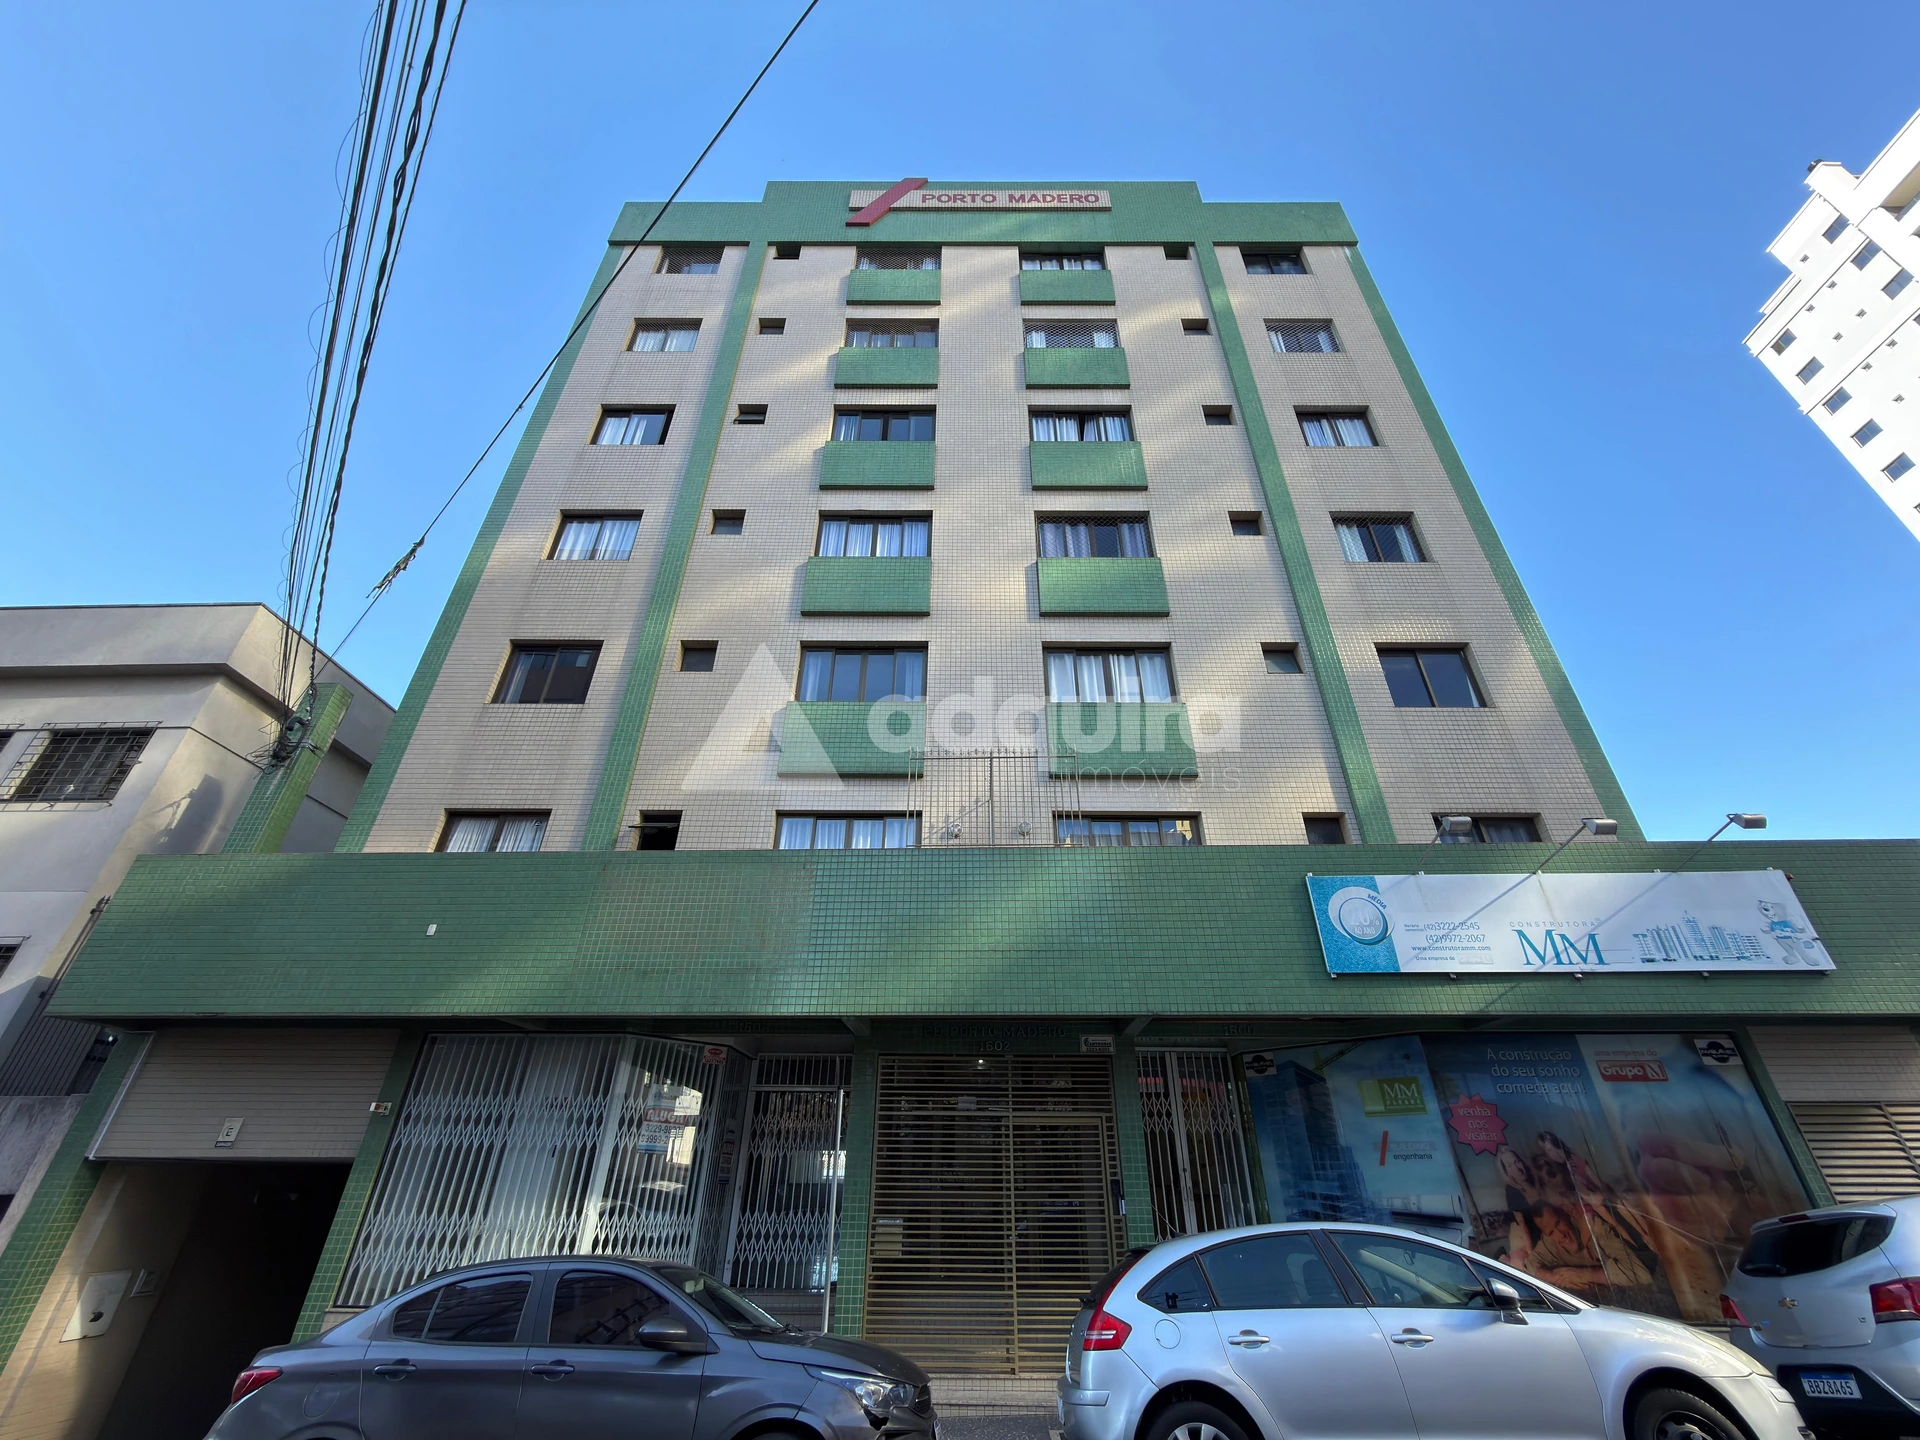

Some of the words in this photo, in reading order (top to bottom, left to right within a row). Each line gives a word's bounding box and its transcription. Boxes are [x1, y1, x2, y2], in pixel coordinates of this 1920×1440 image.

[921, 193, 997, 204] PORTO
[1008, 193, 1100, 204] MADERO
[1512, 929, 1611, 966] MM
[949, 1025, 996, 1037] PORTO
[1002, 1025, 1066, 1037] MADERO
[979, 1040, 1010, 1051] 1602
[1487, 1047, 1497, 1060] A
[1499, 1048, 1572, 1063] construção
[1491, 1064, 1510, 1077] do
[1514, 1066, 1536, 1077] seu
[1540, 1065, 1581, 1078] sonho
[1599, 1063, 1644, 1079] Grupo
[1382, 1083, 1419, 1098] MM
[1497, 1082, 1550, 1096] começa
[1553, 1081, 1588, 1096] aqui!
[1457, 1105, 1491, 1116] venha
[1468, 1120, 1488, 1129] nos
[1465, 1132, 1497, 1141] visitar
[1393, 1152, 1433, 1162] engenharia
[1806, 1379, 1854, 1396] BBZ8A65
